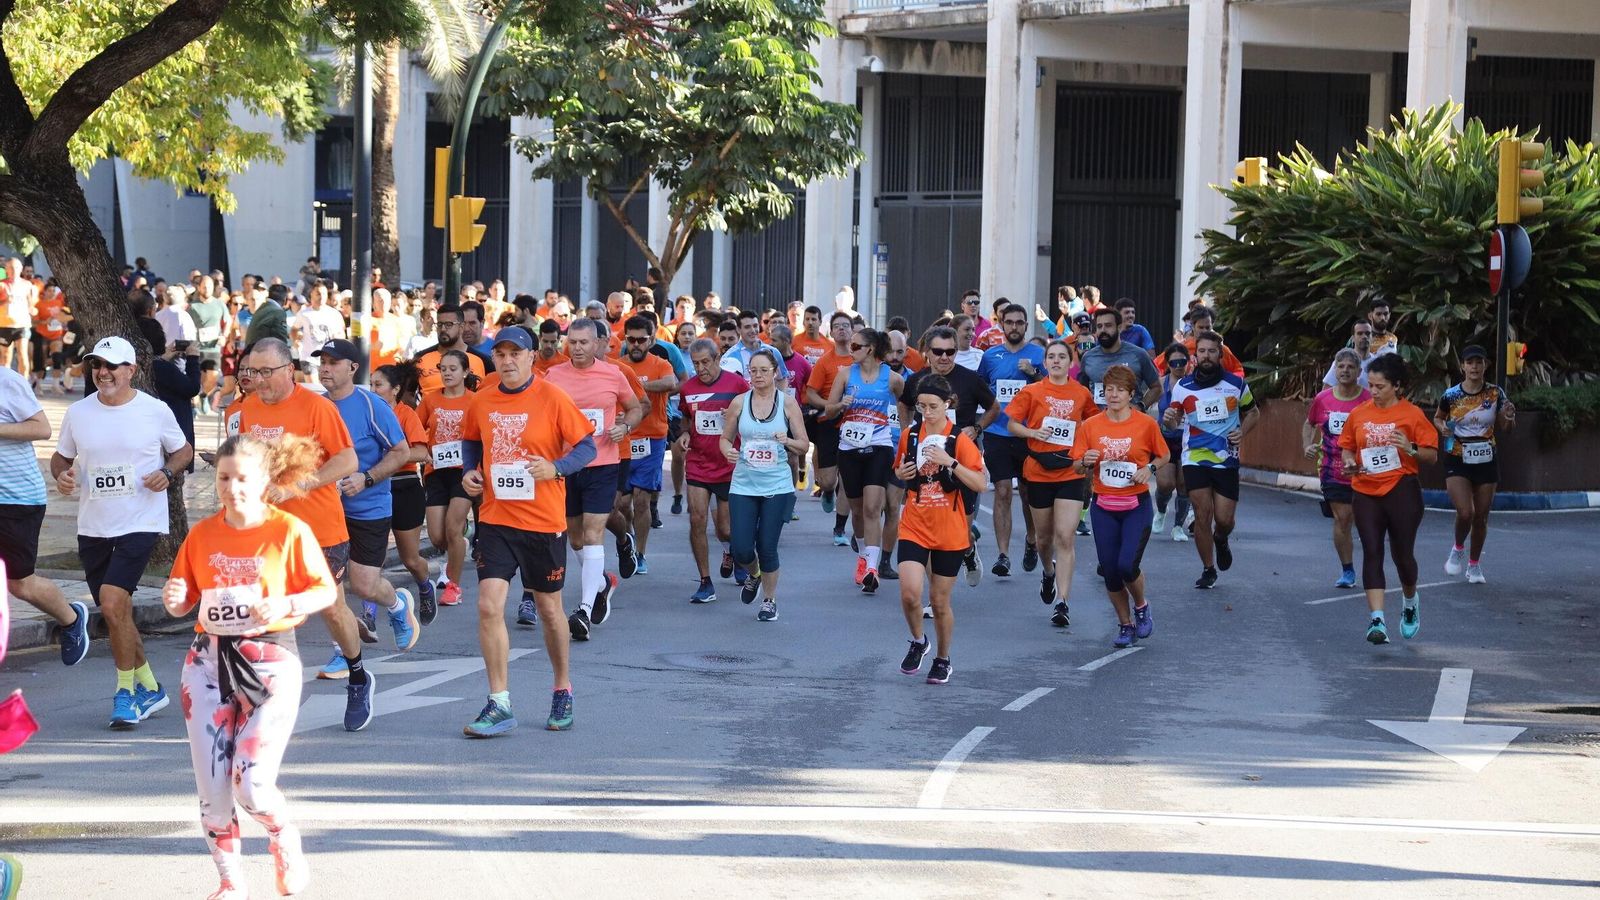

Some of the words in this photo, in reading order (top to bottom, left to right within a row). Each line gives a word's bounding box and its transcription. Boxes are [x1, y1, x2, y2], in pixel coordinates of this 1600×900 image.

[1000, 387, 1020, 395] 912
[853, 398, 883, 406] nerplus
[1204, 405, 1219, 415] 94
[702, 419, 716, 428] 31
[845, 429, 866, 441] 217
[437, 450, 460, 461] 541
[748, 450, 772, 460] 733
[1467, 449, 1492, 457] 1025
[1372, 454, 1388, 466] 55
[1104, 468, 1133, 480] 1005
[95, 475, 126, 489] 601
[497, 477, 525, 488] 995
[207, 604, 251, 622] 620
